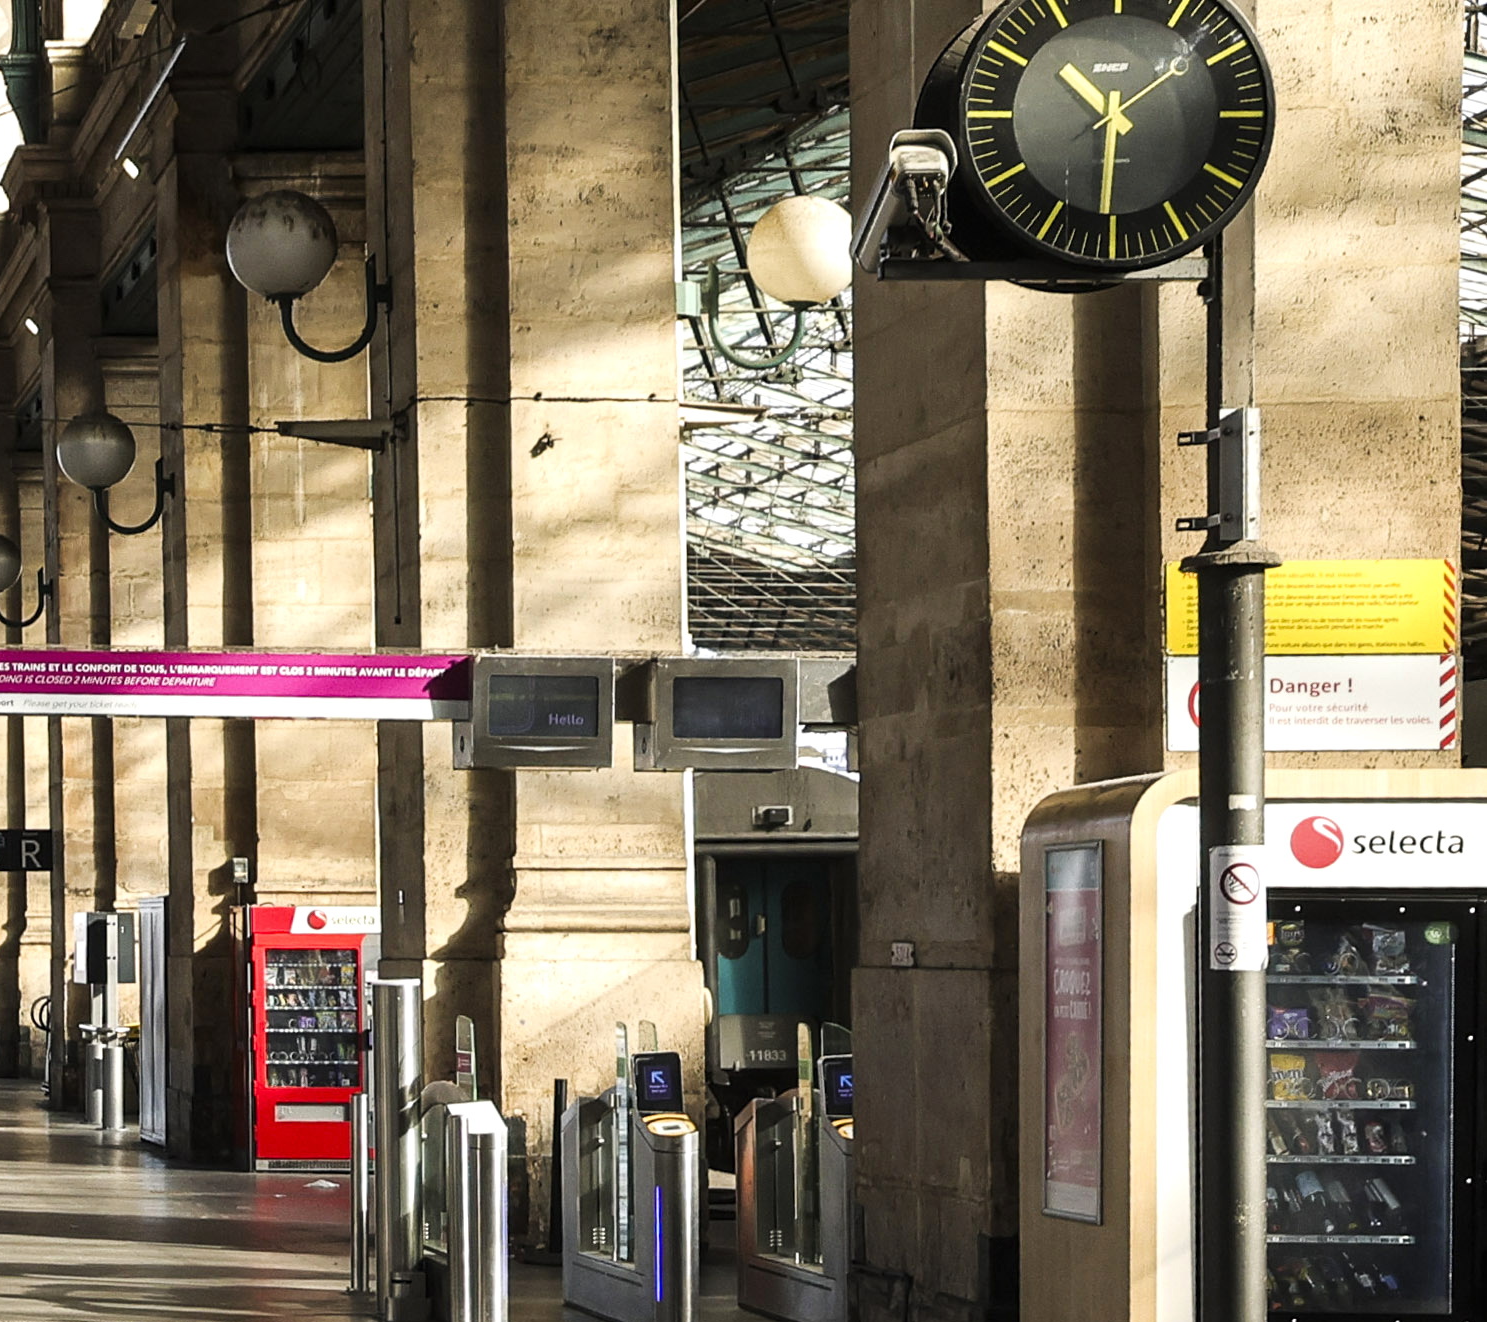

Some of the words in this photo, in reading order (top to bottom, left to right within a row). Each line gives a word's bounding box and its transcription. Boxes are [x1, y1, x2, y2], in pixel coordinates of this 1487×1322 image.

[13, 662, 46, 672] TRAINS
[49, 663, 61, 672] ET
[63, 663, 73, 672] LE
[76, 663, 122, 673] CONFORT
[124, 665, 137, 673] DE
[139, 665, 167, 675] TOUS,
[261, 667, 277, 675] EST
[280, 667, 304, 676] CLOS
[307, 667, 313, 676] 2
[315, 667, 357, 677] MINUTES
[359, 668, 392, 677] AVANT
[395, 669, 405, 677] LE
[25, 675, 32, 683] IS
[35, 675, 71, 685] CLOSED
[73, 676, 80, 684] 2
[81, 676, 122, 686] MINUTES
[124, 677, 160, 686] BEFORE
[162, 677, 215, 687] DEPARTURE
[1270, 678, 1340, 698] Danger
[1348, 678, 1352, 693] !
[24, 699, 47, 707] Please
[49, 700, 63, 708] get
[66, 701, 84, 709] your
[1269, 703, 1292, 712] Pour
[1295, 704, 1323, 712] votre
[1326, 702, 1368, 712] sécurité
[548, 714, 584, 725] Hello
[1277, 717, 1291, 725] est
[1294, 716, 1329, 725] interdit
[1332, 716, 1344, 725] de
[1346, 717, 1388, 725] traverser
[1390, 716, 1404, 725] les
[1407, 716, 1434, 725] voies.
[1352, 830, 1464, 855] selecta
[22, 840, 41, 868] R
[331, 914, 375, 926] selecta
